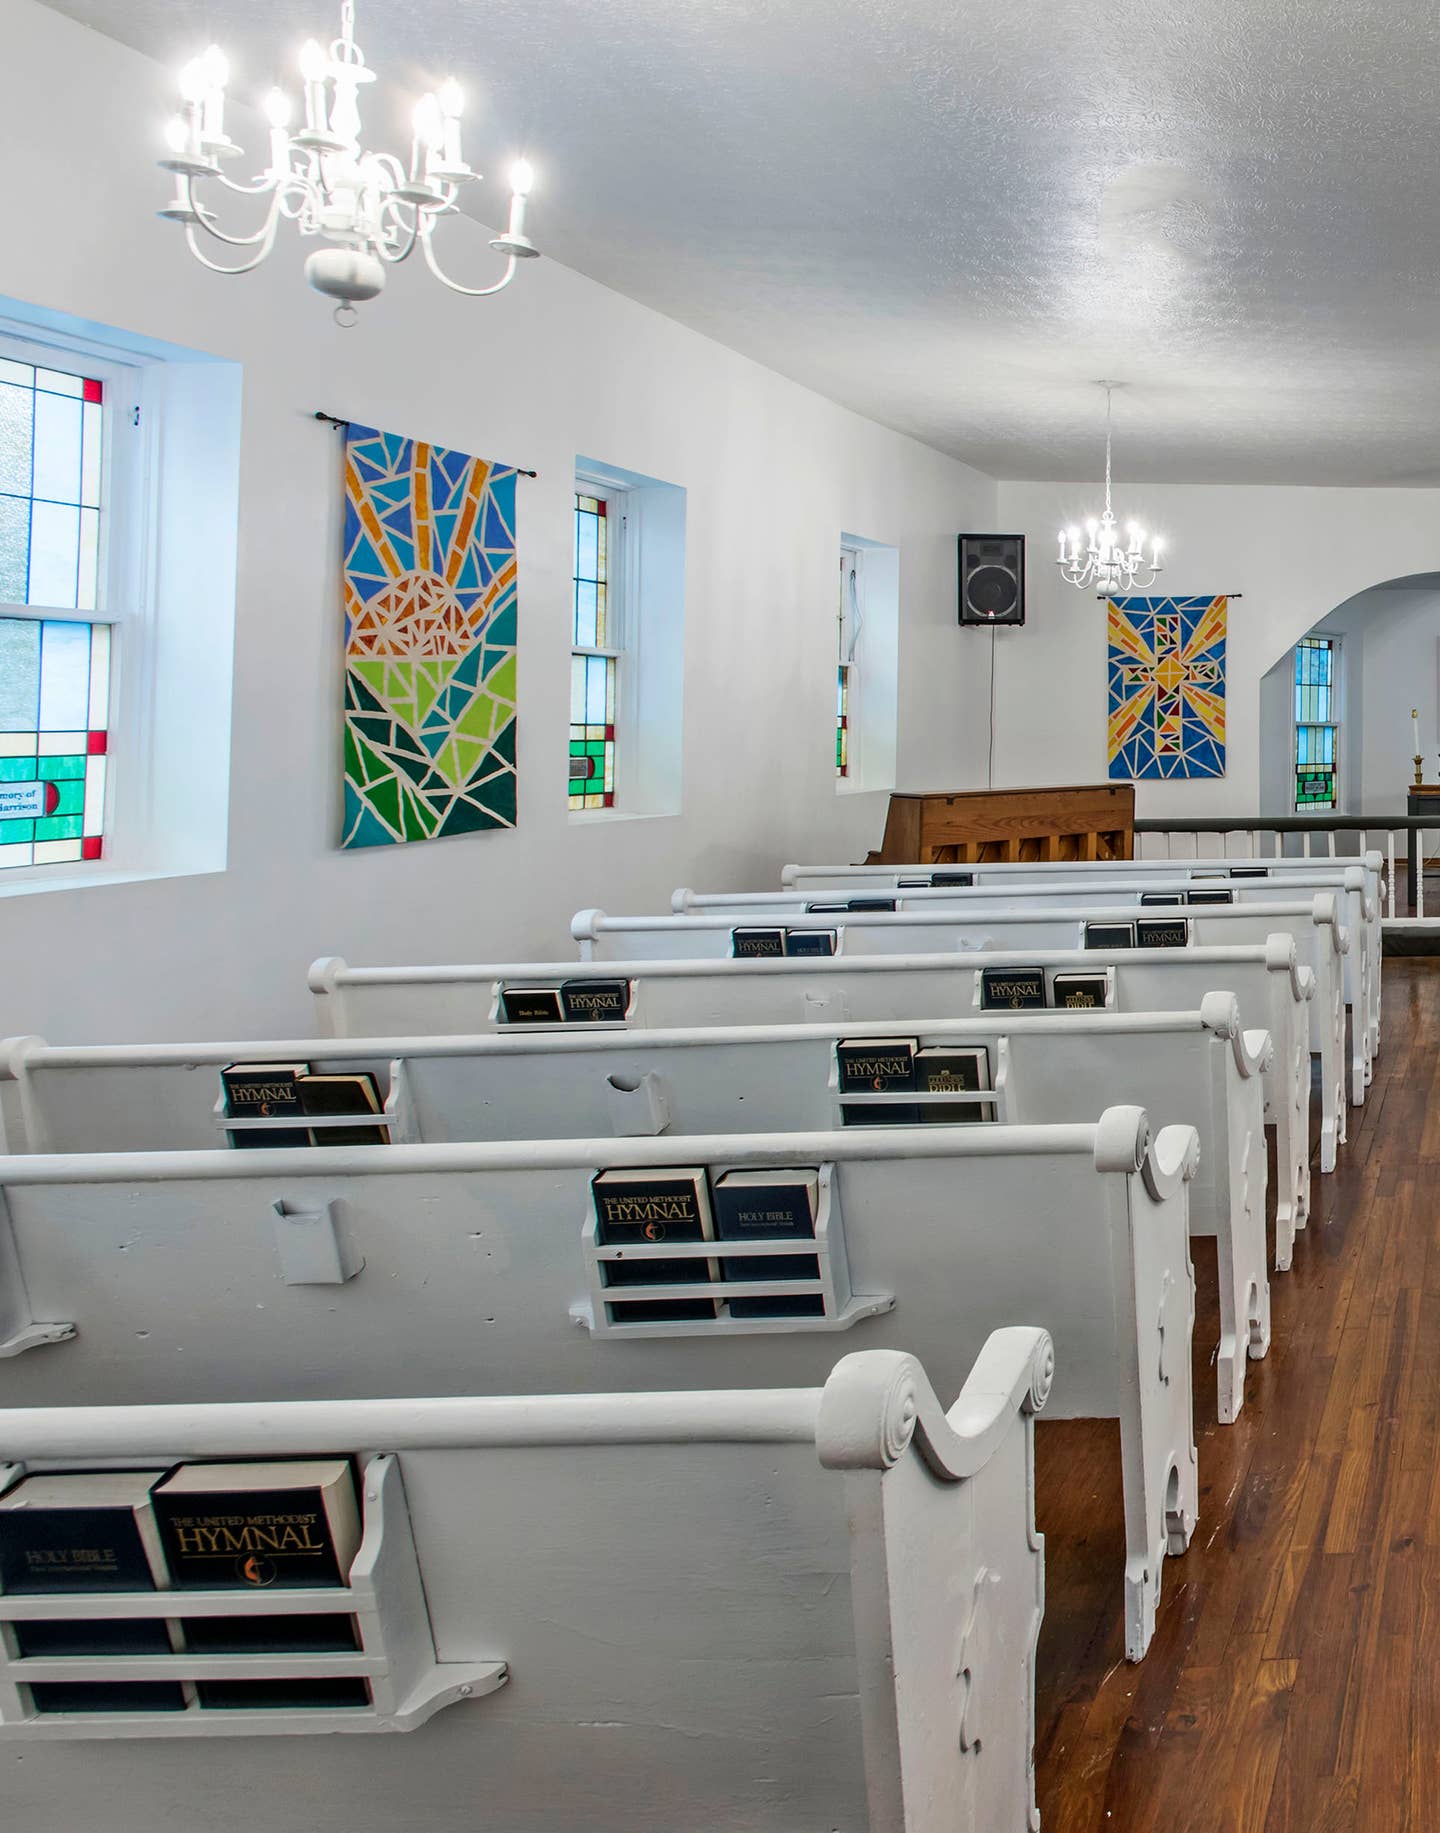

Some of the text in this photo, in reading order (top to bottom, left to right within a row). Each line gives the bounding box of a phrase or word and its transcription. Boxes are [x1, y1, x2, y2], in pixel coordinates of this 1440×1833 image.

[1143, 933, 1184, 942] HYMNAL
[739, 942, 780, 951] HYMNAL
[991, 985, 1040, 996] HYMNAL
[570, 997, 621, 1009] HYMNAL
[846, 1062, 911, 1076] HYMNAL
[231, 1087, 297, 1102] HYMNAL
[606, 1203, 696, 1220] HYMNAL
[738, 1211, 793, 1221] HOLY BIBLE
[169, 1513, 317, 1527] THE UNITED METHODIST
[176, 1525, 325, 1552] HYMNAL
[26, 1549, 117, 1564] HOLY BIBLE
